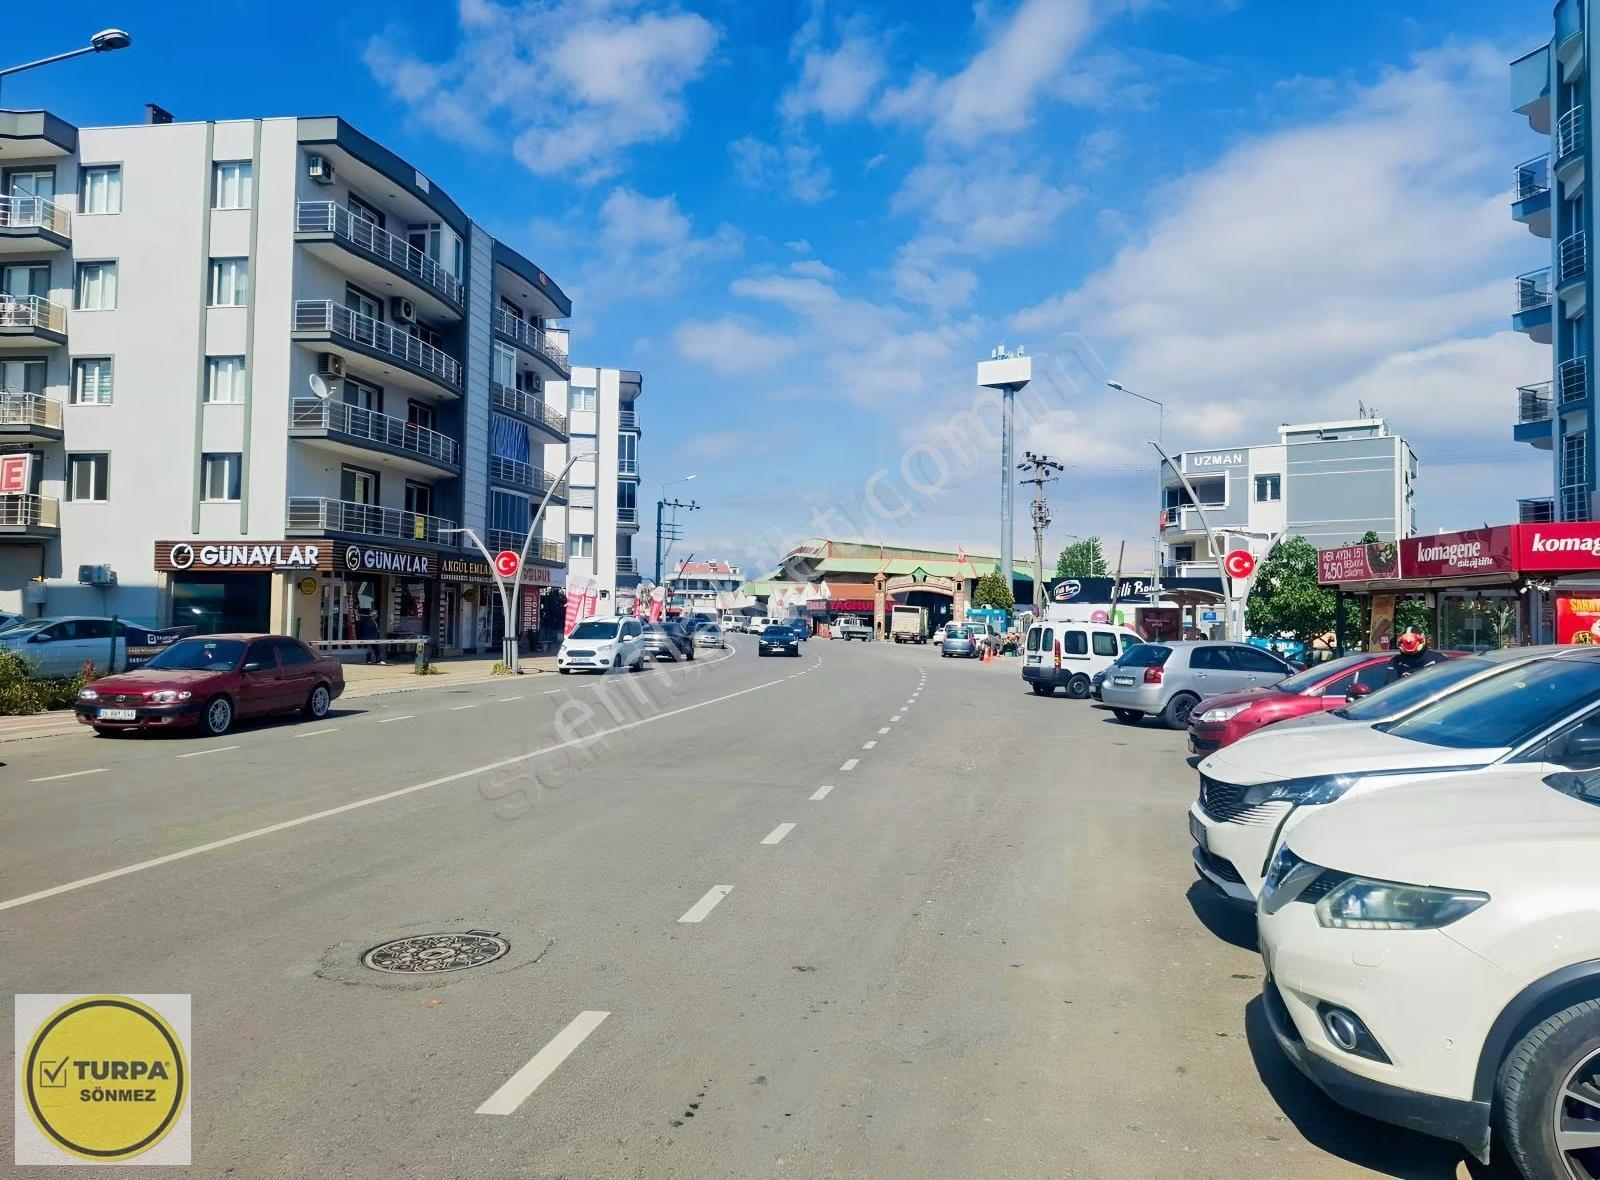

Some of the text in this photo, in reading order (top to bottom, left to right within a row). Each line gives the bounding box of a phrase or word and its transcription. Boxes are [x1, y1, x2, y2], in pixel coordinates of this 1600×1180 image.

[1194, 454, 1242, 466] UZMAN
[5, 461, 23, 489] E
[200, 545, 319, 566] GÜNAYLAR
[364, 549, 428, 574] GÜNAYLAR
[1322, 551, 1334, 562] HER
[1418, 541, 1481, 565] komagene
[442, 559, 492, 576] AKGÜL EMLA
[1323, 562, 1343, 580] %50
